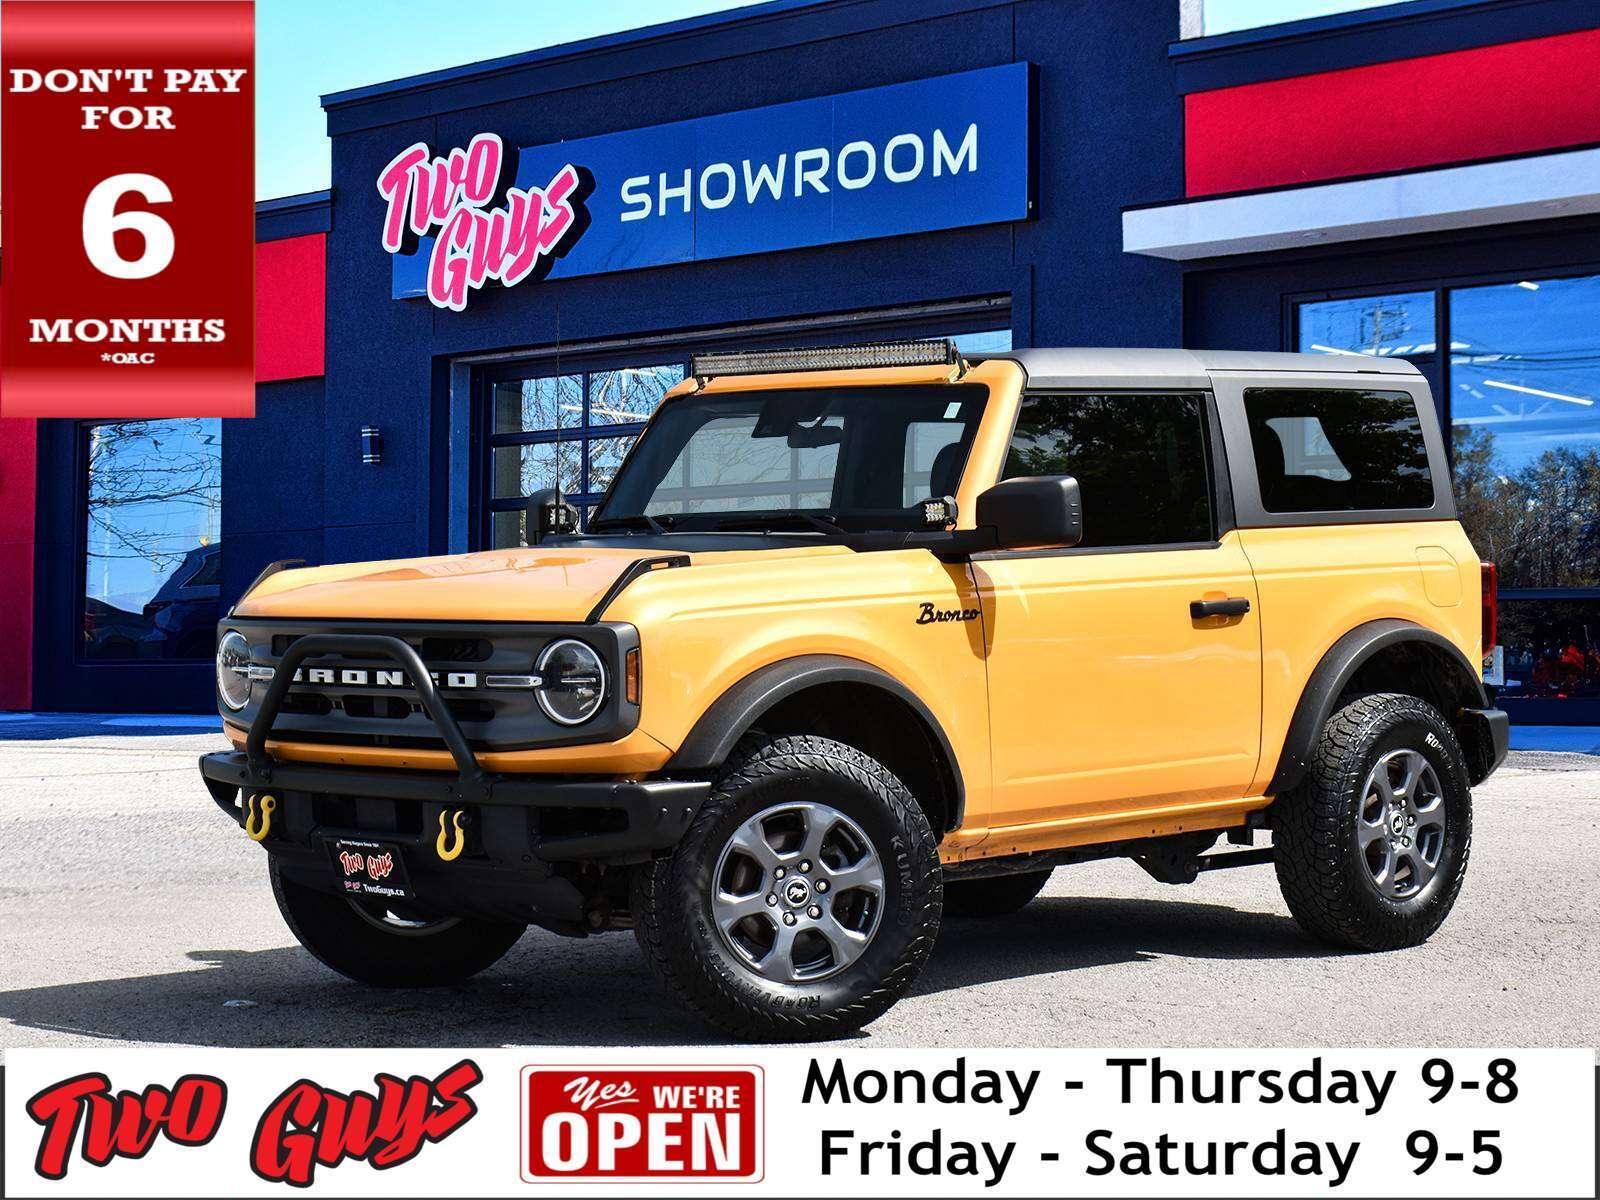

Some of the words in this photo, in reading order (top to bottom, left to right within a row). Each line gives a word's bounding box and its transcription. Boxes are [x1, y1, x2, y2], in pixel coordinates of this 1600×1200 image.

[376, 133, 503, 254] Two
[620, 123, 978, 222] SHOWROOM
[427, 164, 579, 311] Guys
[916, 602, 980, 625] Bronco
[292, 667, 477, 688] RONO
